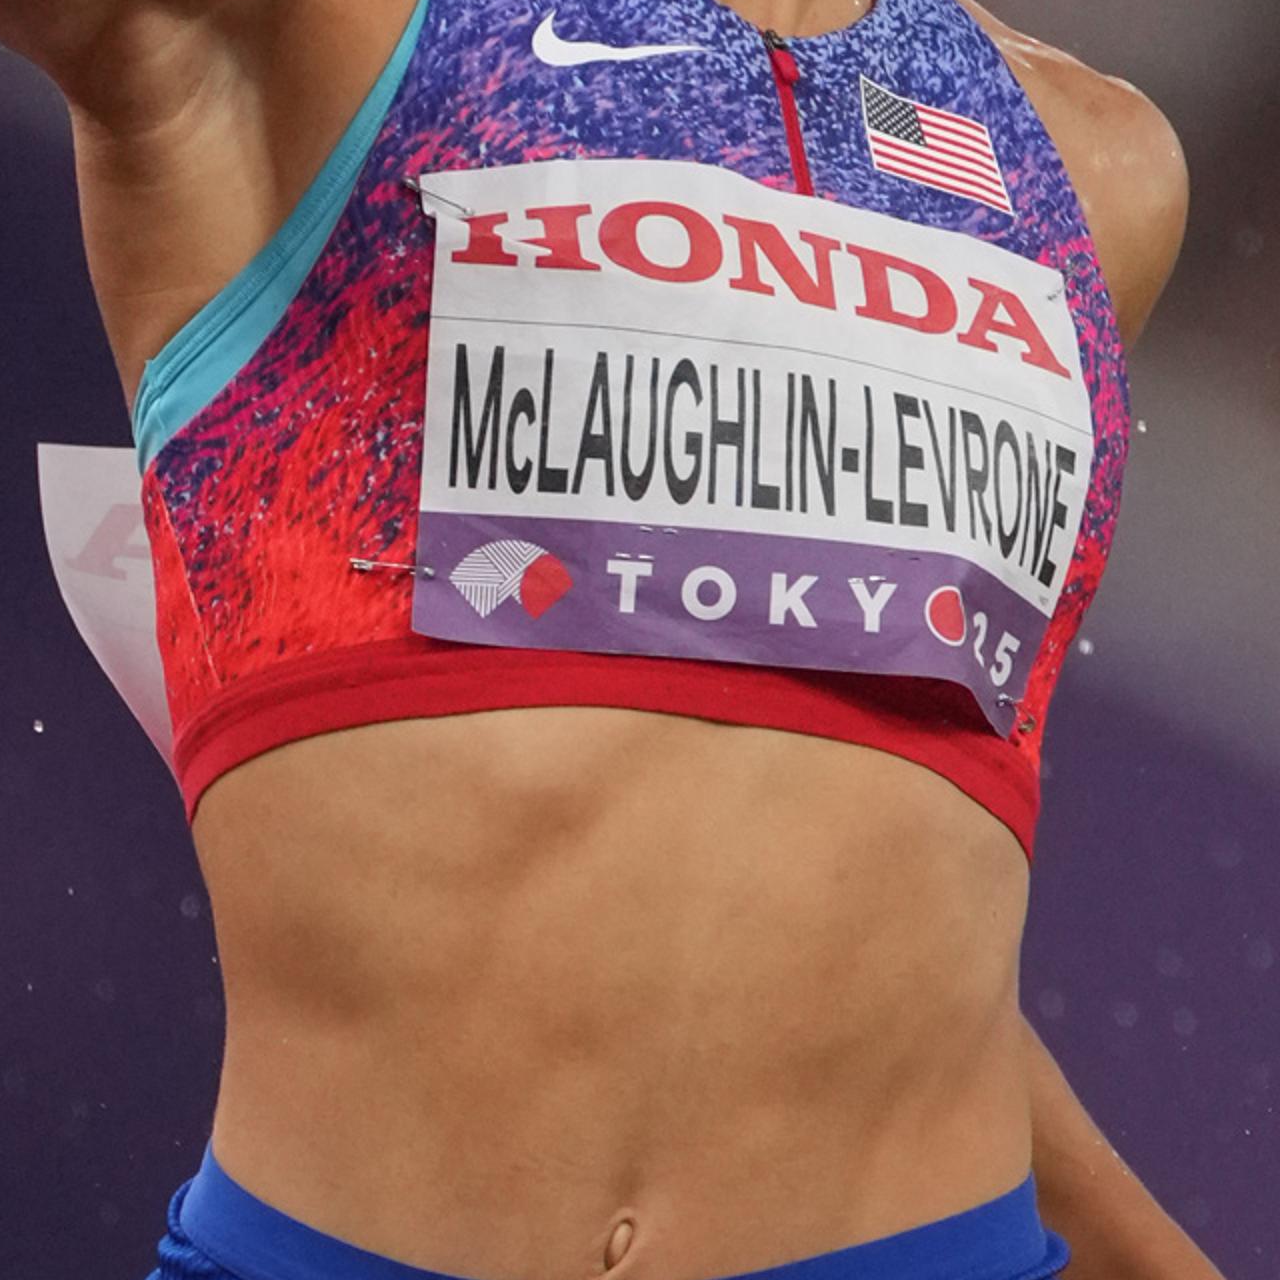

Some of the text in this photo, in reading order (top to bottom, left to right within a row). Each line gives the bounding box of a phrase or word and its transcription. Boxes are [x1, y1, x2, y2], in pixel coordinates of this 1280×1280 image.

[451, 201, 1072, 380] HONDA
[448, 342, 1077, 588] McLAUGHLIN-LEVRONE
[972, 611, 1021, 687] 25
